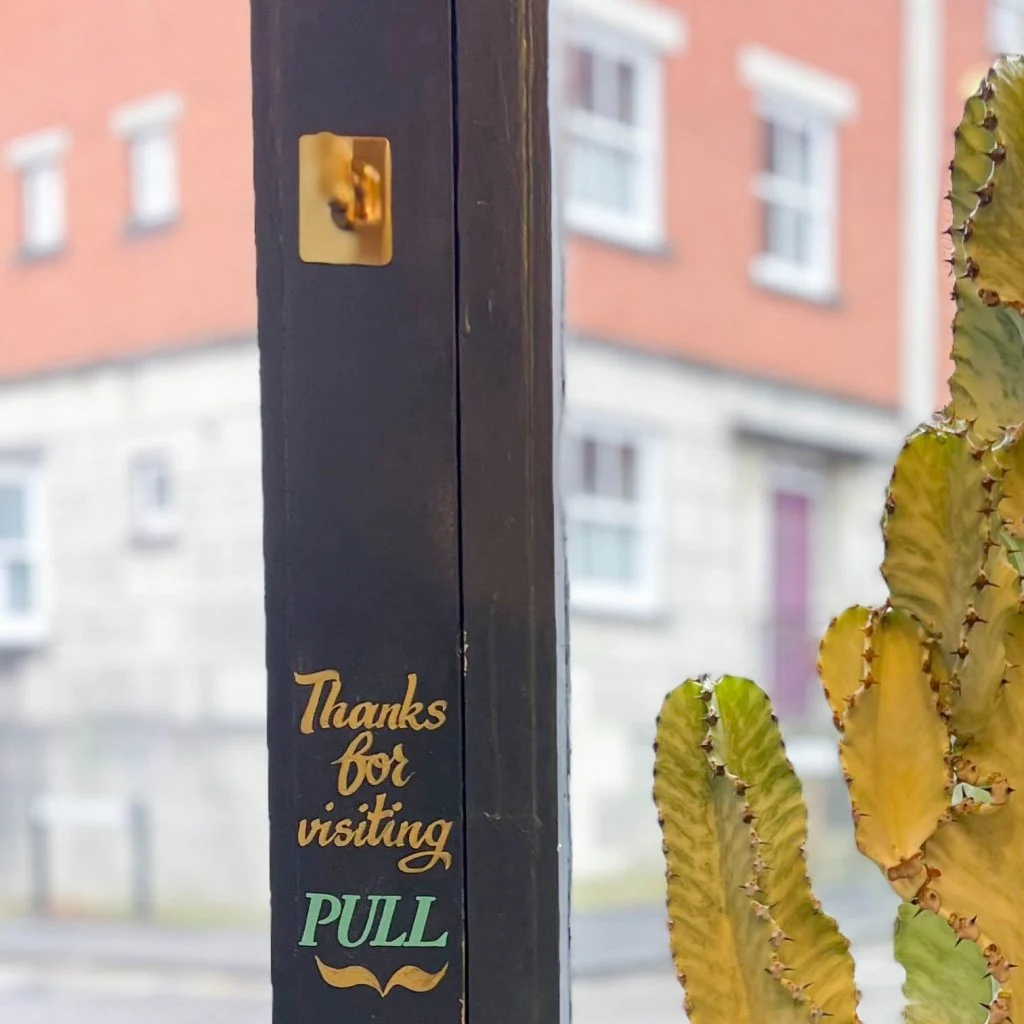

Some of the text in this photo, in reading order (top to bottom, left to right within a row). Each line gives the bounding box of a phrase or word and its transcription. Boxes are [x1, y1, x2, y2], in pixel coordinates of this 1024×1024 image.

[294, 669, 448, 734] Thanks
[331, 730, 415, 797] for
[297, 793, 453, 874] visiting
[298, 892, 449, 948] PULL
